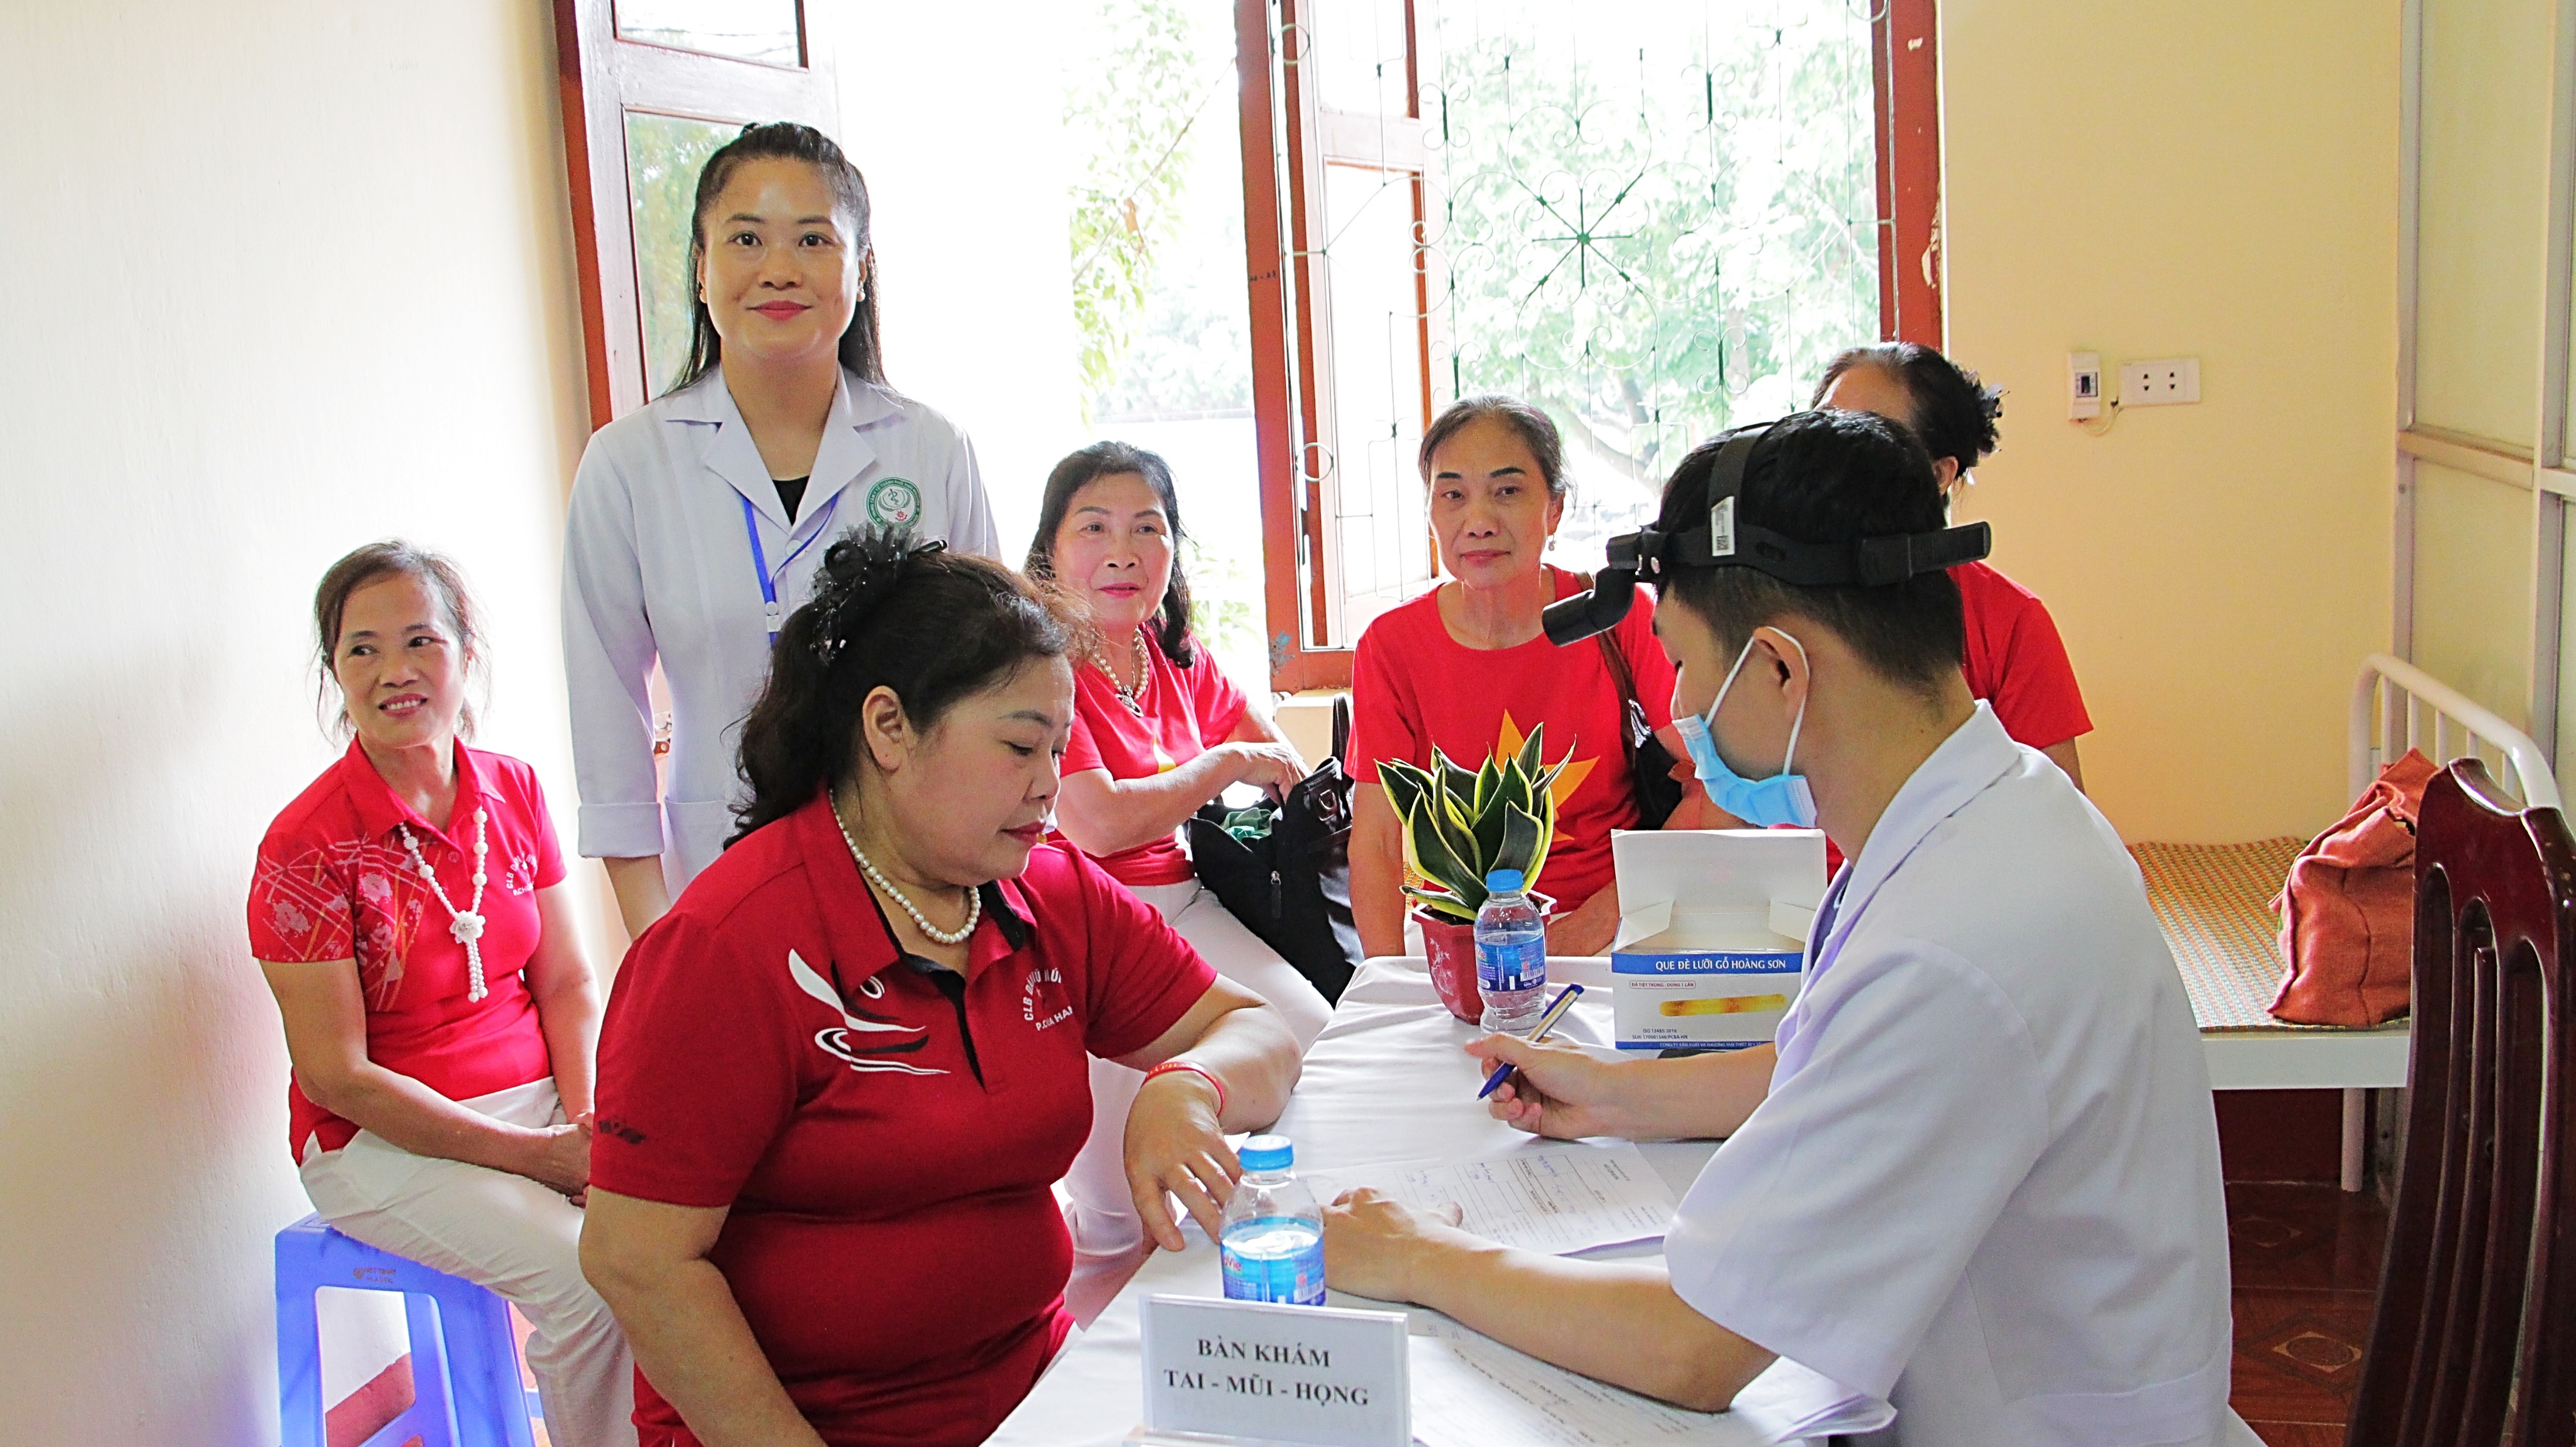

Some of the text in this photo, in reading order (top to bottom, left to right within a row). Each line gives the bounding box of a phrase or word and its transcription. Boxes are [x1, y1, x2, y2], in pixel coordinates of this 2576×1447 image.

[506, 872, 514, 889] CLB
[1655, 957, 1786, 971] QUE ĐÈ LƯỠI GỖ HOÀNG SƠN
[1023, 997, 1034, 1021] CLB
[1197, 1335, 1330, 1367] BÀN KHÁM
[1163, 1369, 1204, 1389] TAI
[1227, 1374, 1272, 1397] MŨI
[1296, 1383, 1369, 1406] HỌNG
